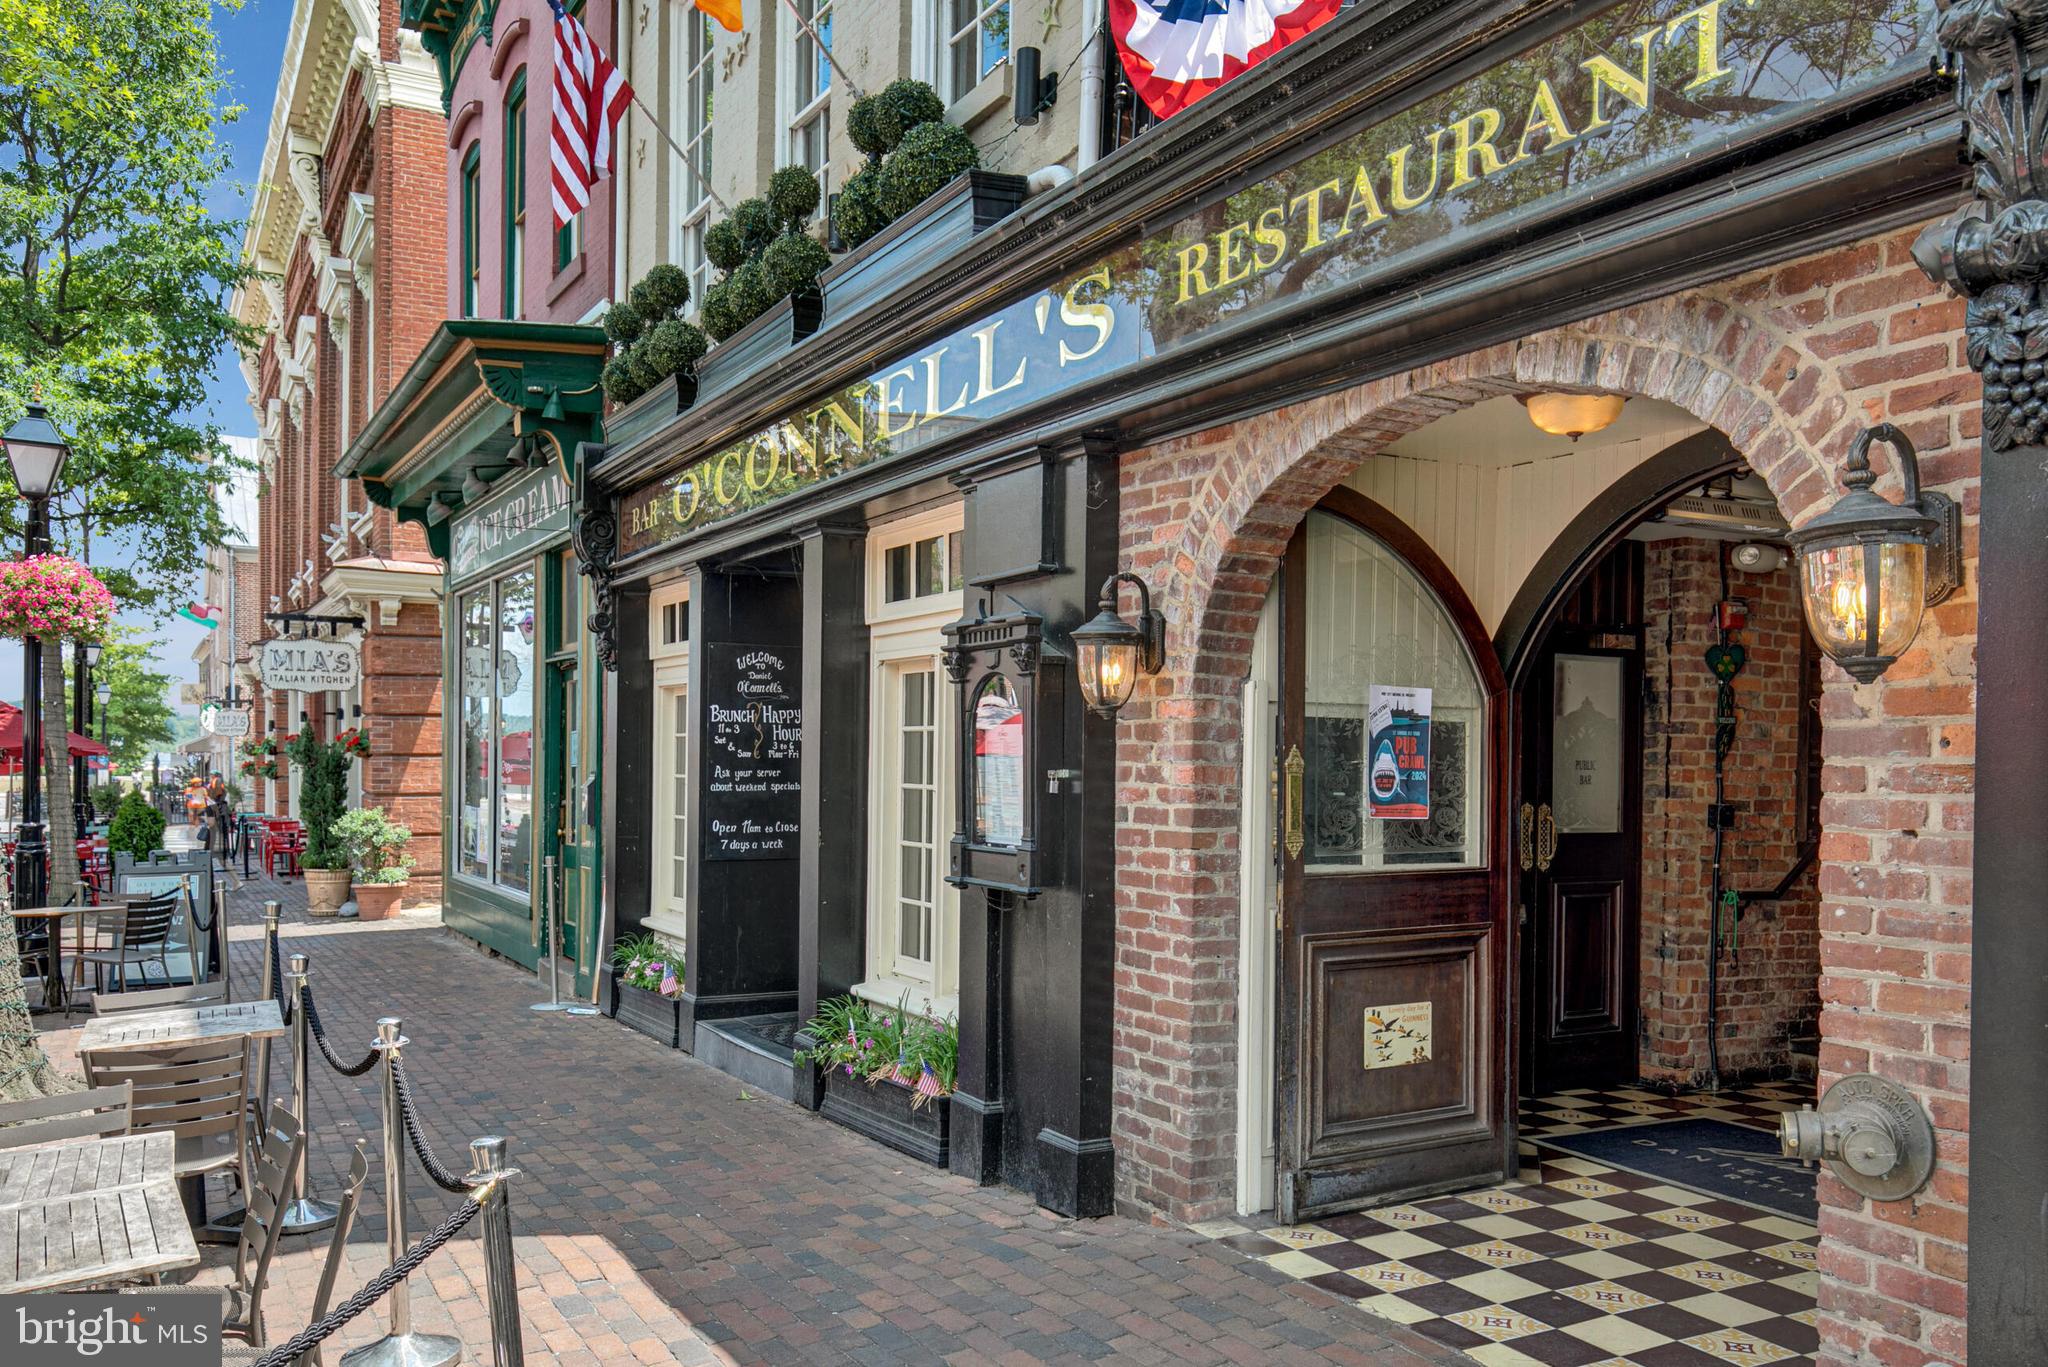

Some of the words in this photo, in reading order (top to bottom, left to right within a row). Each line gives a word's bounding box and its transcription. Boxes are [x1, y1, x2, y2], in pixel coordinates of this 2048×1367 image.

[631, 500, 659, 536] BAR
[671, 267, 1116, 525] O'CONNELL'S
[1174, 0, 1758, 306] RESTAURANT
[479, 508, 502, 554] ICE
[504, 474, 568, 541] CREAM
[269, 649, 351, 674] MIA'S
[736, 651, 785, 670] WELCOME
[755, 662, 766, 670] TO
[270, 674, 305, 683] ITALIAN
[310, 675, 350, 684] KITCHEN
[748, 671, 772, 680] Daniel
[734, 724, 740, 734] 3
[773, 724, 802, 741] HOUR
[714, 735, 727, 744] Sat
[772, 741, 778, 750] 3
[789, 741, 795, 750] 6
[1395, 736, 1417, 754] PUB
[714, 765, 731, 779] Ask
[734, 769, 753, 782] your
[757, 769, 781, 778] server
[710, 782, 733, 792] about
[735, 782, 766, 792] weekend
[712, 820, 737, 836] Open
[741, 820, 761, 834] 11am
[720, 839, 728, 850] 7
[729, 839, 750, 853] days
[751, 841, 758, 849] a
[761, 839, 783, 849] week
